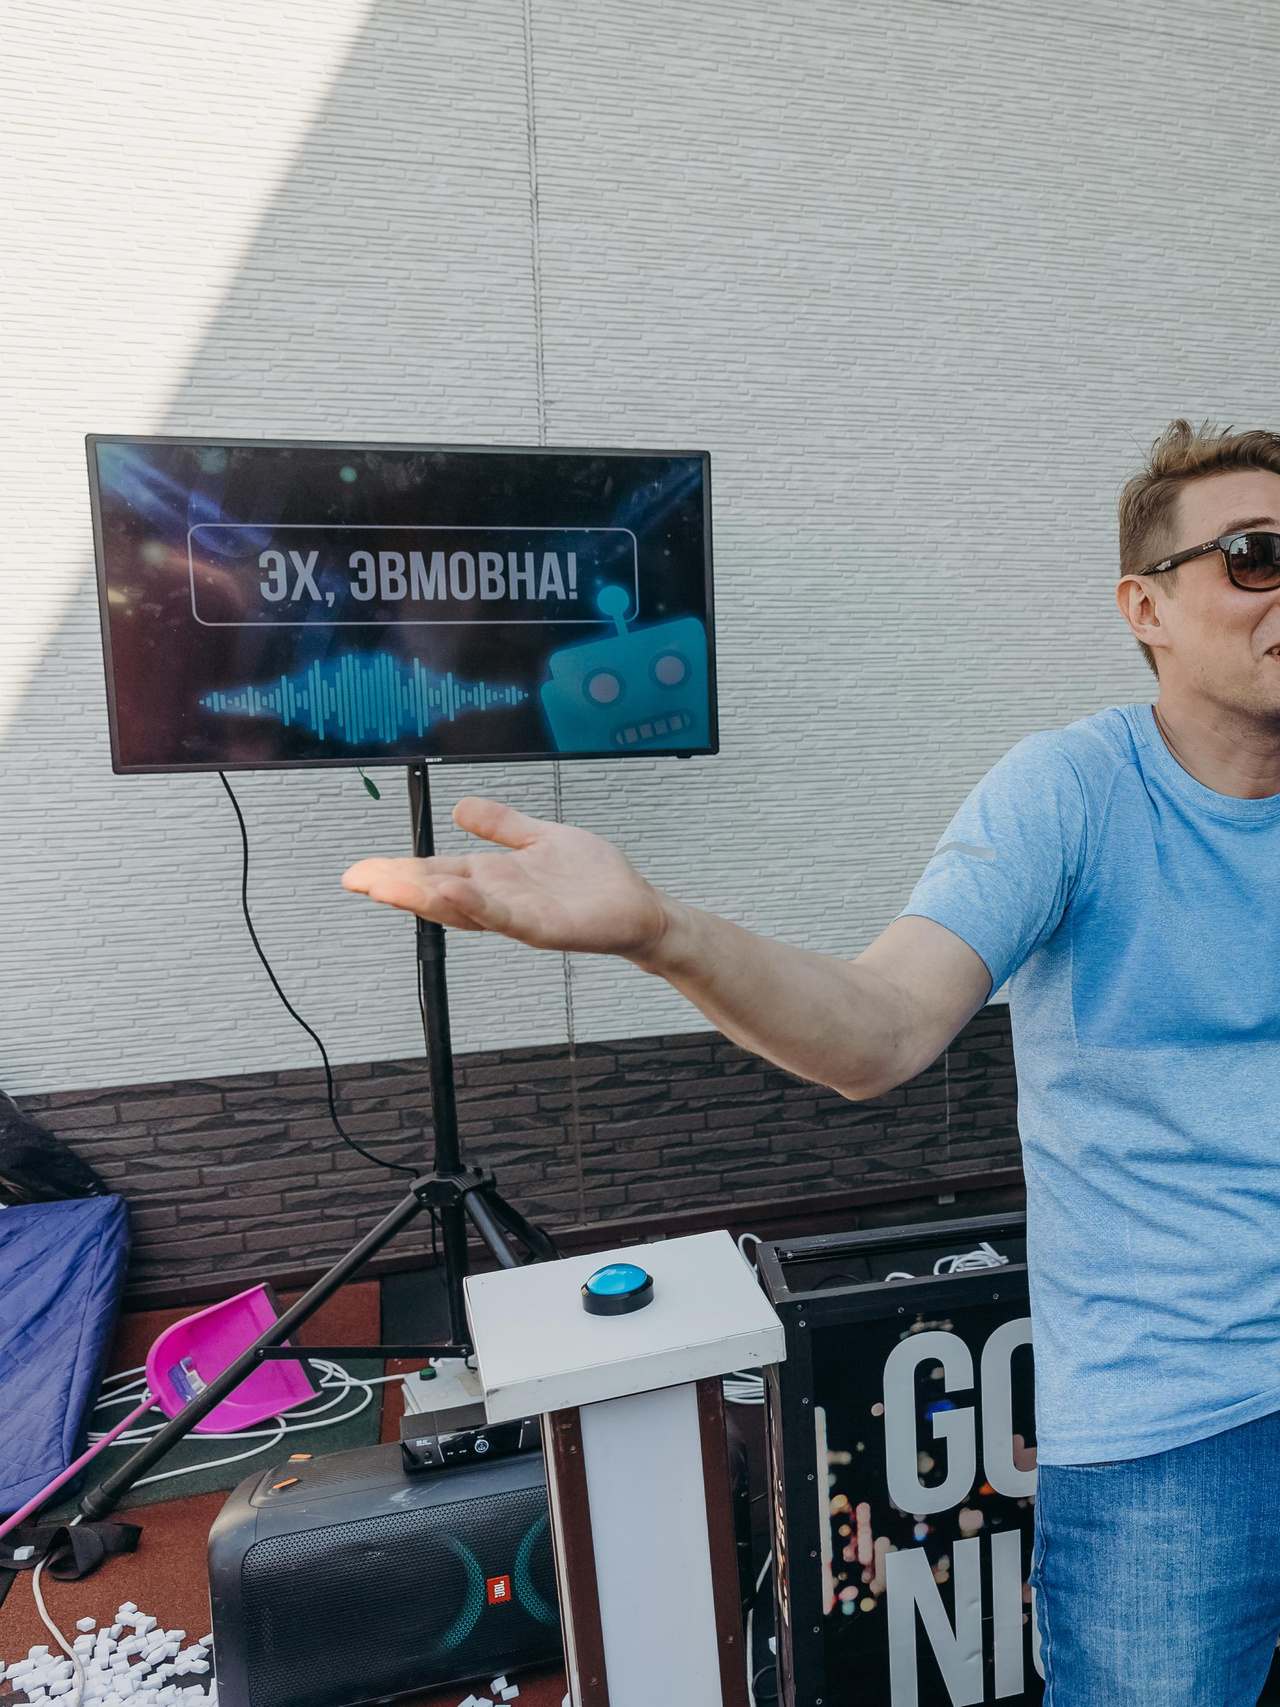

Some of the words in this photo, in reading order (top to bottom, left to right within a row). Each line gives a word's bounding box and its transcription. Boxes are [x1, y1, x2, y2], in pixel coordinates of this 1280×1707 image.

[258, 550, 335, 607] ЭХ,
[349, 550, 578, 601] ЭВМОВНА!
[494, 1580, 506, 1599] JBL
[885, 1529, 1046, 1707] NI
